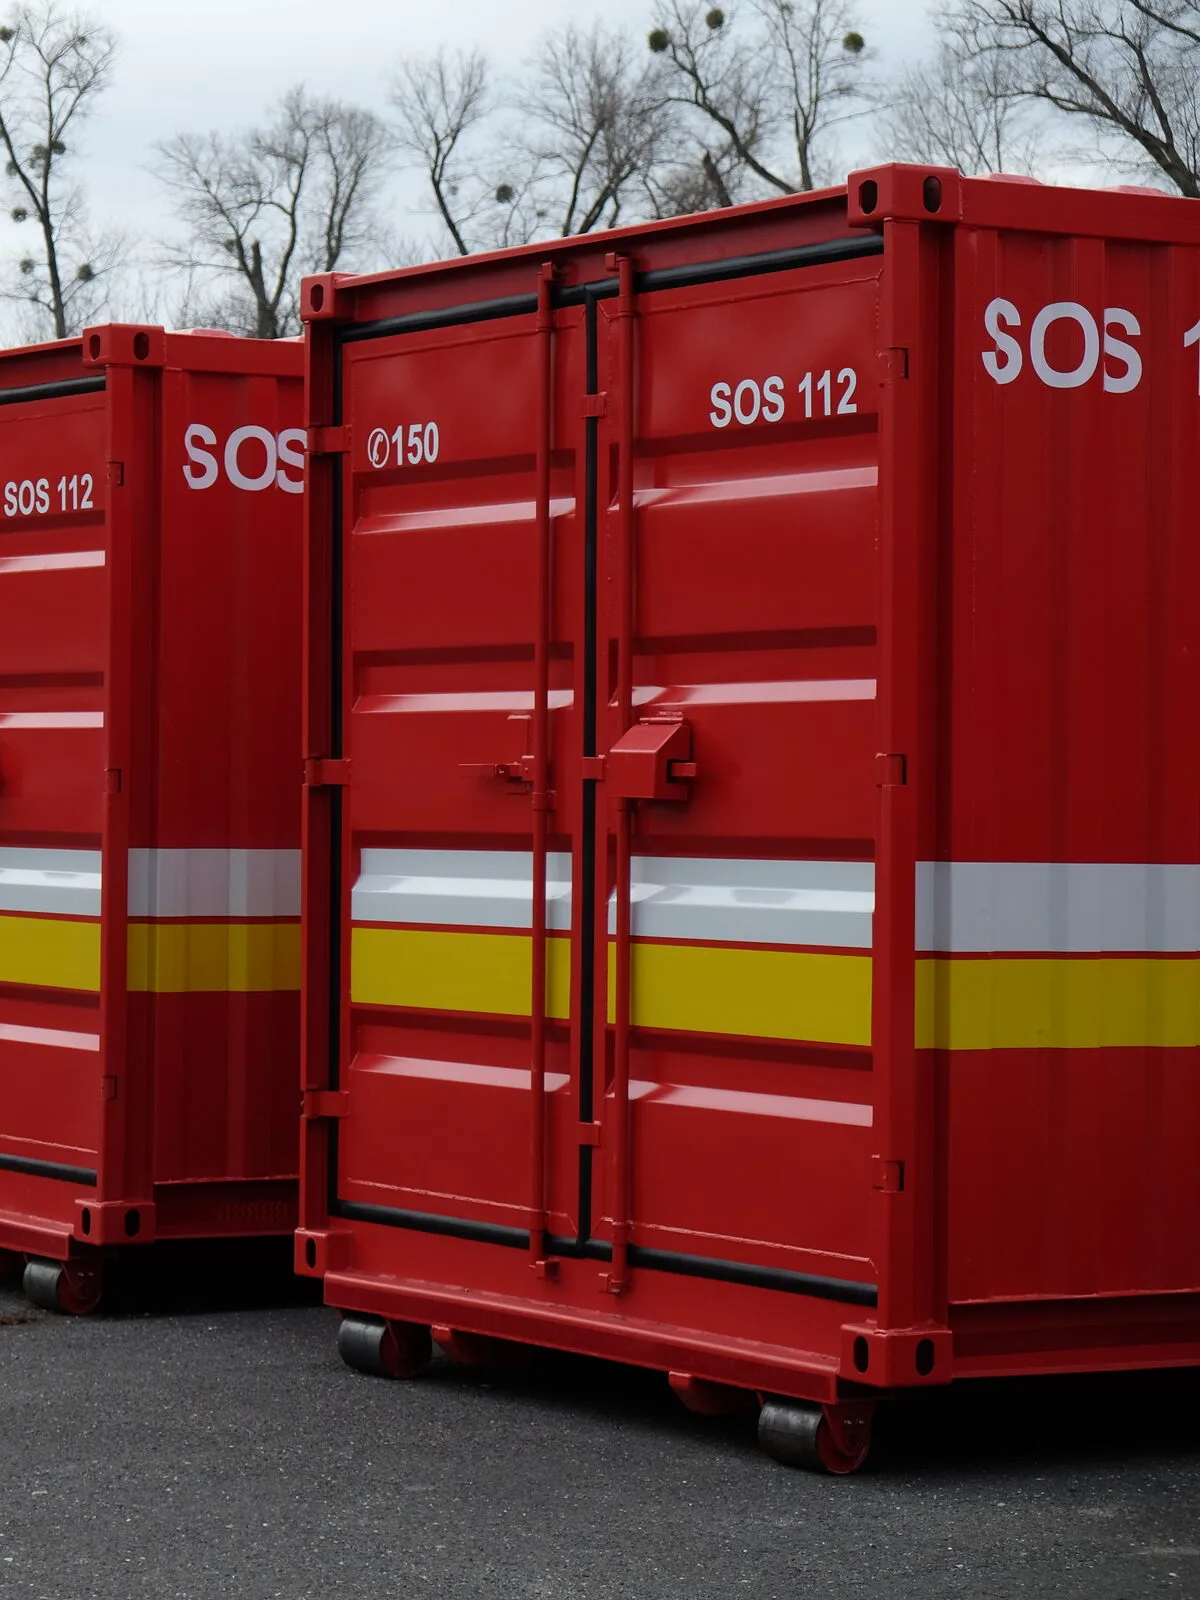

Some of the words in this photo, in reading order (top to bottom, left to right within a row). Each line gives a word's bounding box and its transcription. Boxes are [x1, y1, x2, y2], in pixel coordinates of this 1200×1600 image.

[982, 298, 1142, 393] SOS
[709, 376, 785, 427] SOS
[798, 368, 857, 417] 112
[182, 423, 307, 493] SOS
[392, 422, 439, 465] 150
[4, 478, 49, 516] SOS
[57, 473, 93, 511] 112
